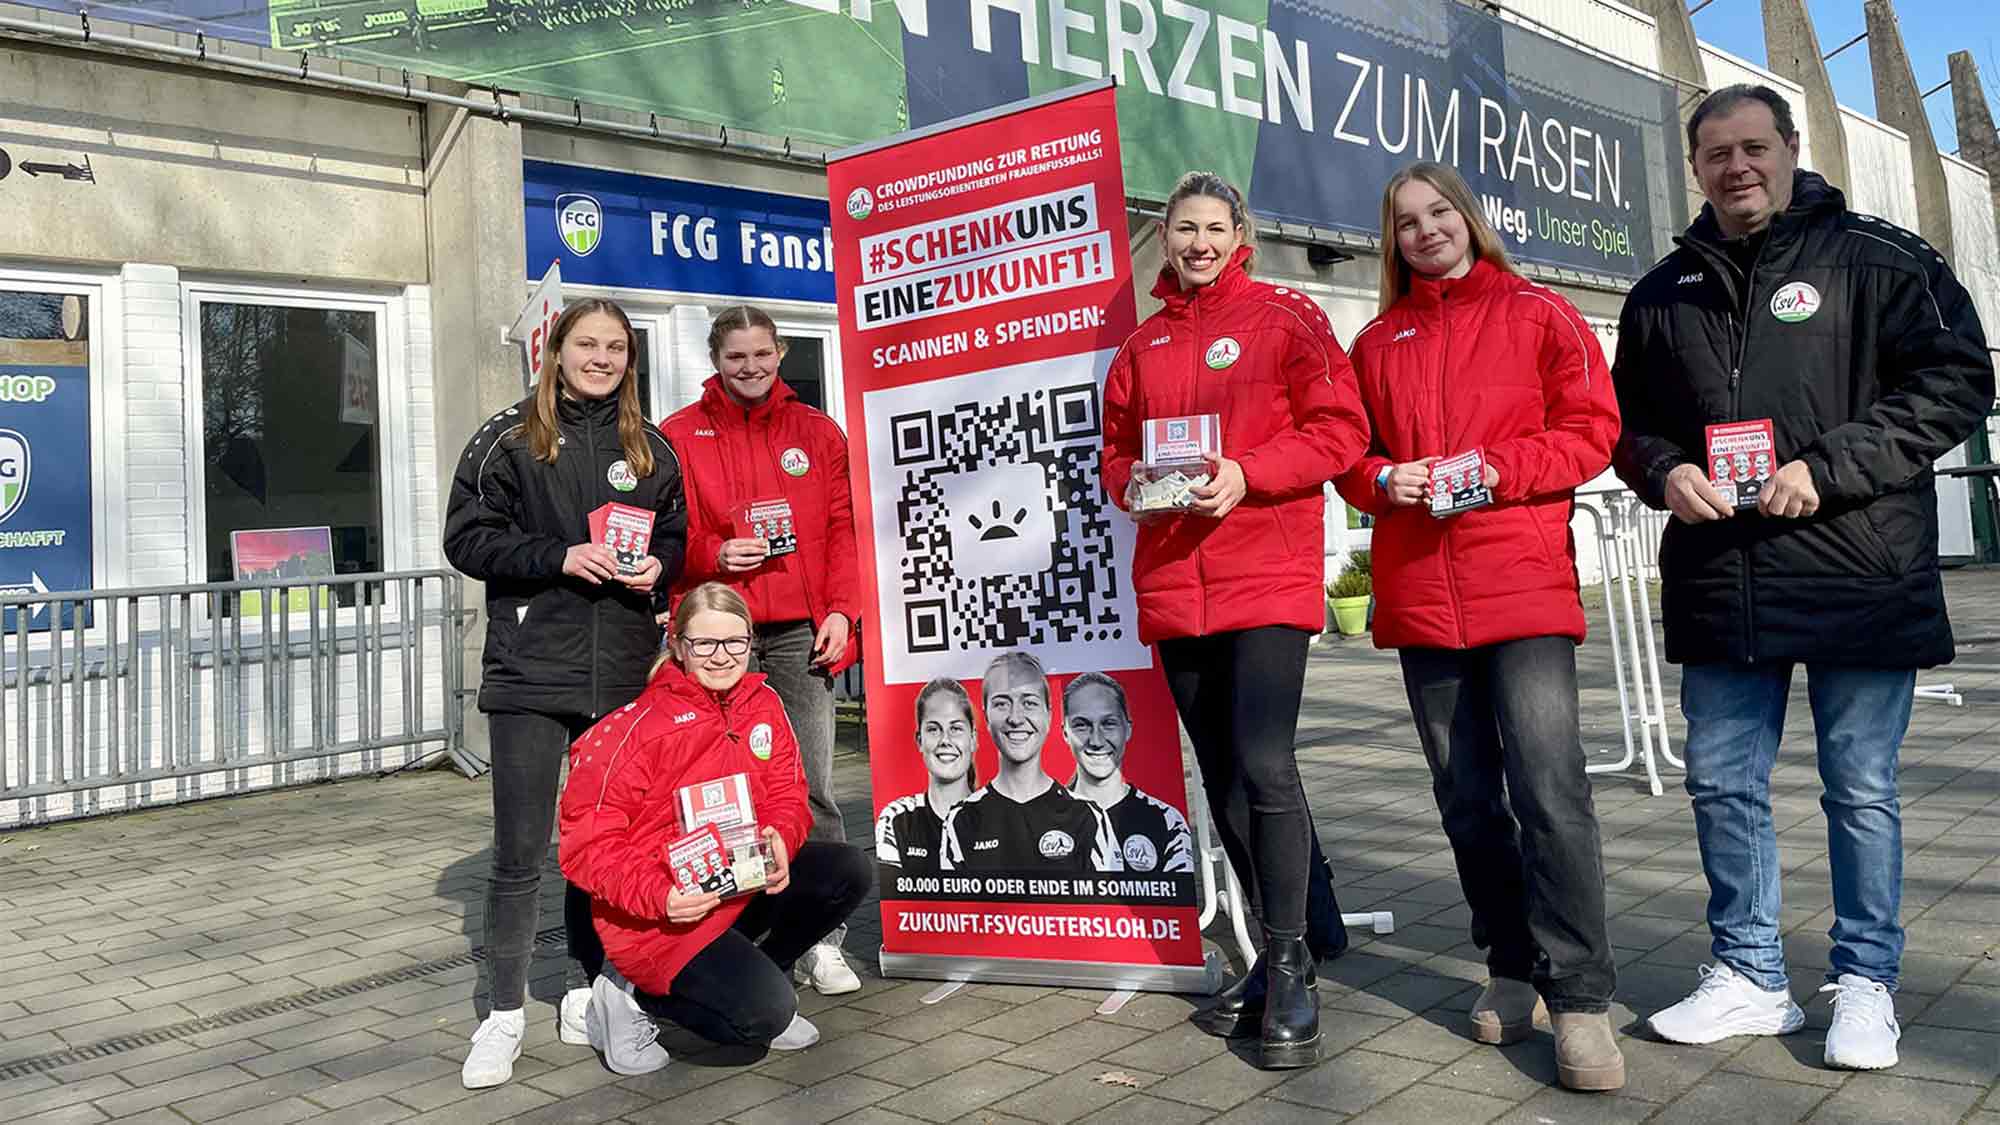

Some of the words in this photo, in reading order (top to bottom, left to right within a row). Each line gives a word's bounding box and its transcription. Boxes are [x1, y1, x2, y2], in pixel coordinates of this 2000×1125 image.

[1333, 52, 1460, 168] ZUM
[1479, 97, 1631, 210] RASEN.
[876, 157, 994, 200] CROWDFUNDING
[998, 149, 1026, 169] ZUR
[1031, 129, 1102, 161] RETTUNG
[878, 200, 894, 213] DES
[896, 172, 1008, 209] LEISTUNGSORIENTIERTEN
[1008, 147, 1103, 180] FRAUENFUSSBALLS!
[565, 211, 596, 227] FCG
[650, 211, 718, 261] FCG
[868, 195, 1088, 274] #SCHENKUNS
[1536, 207, 1588, 247] Unser
[1591, 218, 1634, 259] Spiel.
[863, 242, 1102, 322] EINEZUKUNFT!
[1677, 272, 1703, 284] JAKO
[873, 331, 969, 368] SCANNEN
[974, 328, 989, 348] &
[995, 305, 1106, 345] SPENDEN:
[1392, 328, 1416, 342] JAKO
[674, 711, 696, 724] JAKO
[973, 839, 999, 850] JAKO
[897, 877, 940, 894] 80.000
[943, 878, 981, 894] EURO
[985, 878, 1026, 895] ODER
[1029, 879, 1069, 895] ENDE
[1073, 880, 1094, 896] IM
[1098, 880, 1177, 897] SOMMER!
[898, 911, 1181, 940] ZUKUNFT.FSVGUETERSLOH.DE
